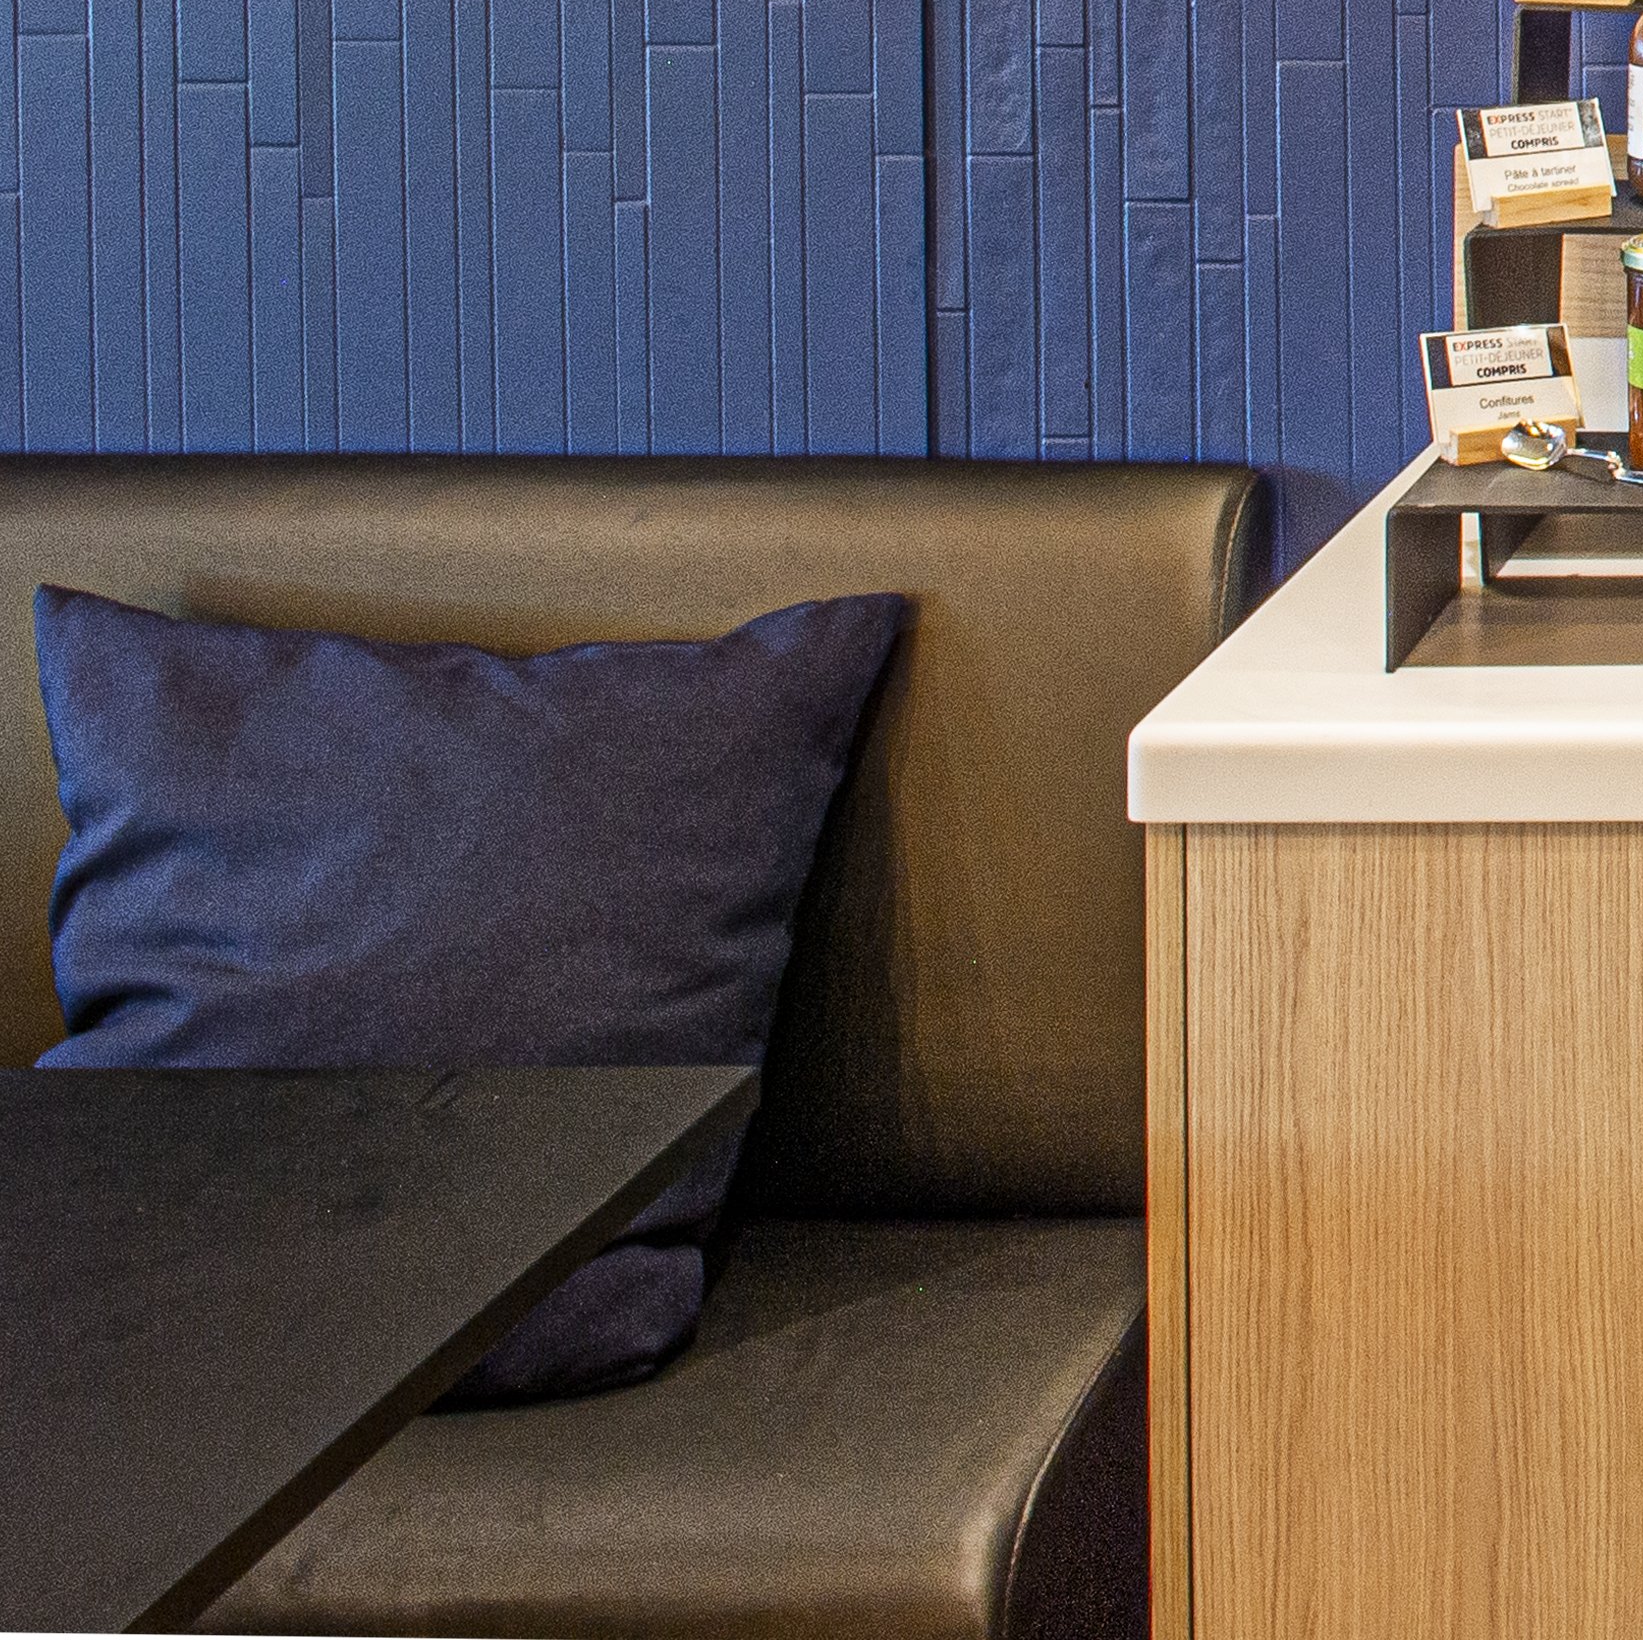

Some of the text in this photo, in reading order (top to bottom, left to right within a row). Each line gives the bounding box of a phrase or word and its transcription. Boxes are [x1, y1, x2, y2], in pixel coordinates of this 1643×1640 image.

[1487, 111, 1535, 125] EXPRESS
[1511, 136, 1559, 150] COMPRIS
[1504, 165, 1576, 181] Pâte à tartiner
[1452, 337, 1503, 352] EXPRESS
[1476, 363, 1527, 378] COMPRIS
[1479, 394, 1535, 409] Confitures
